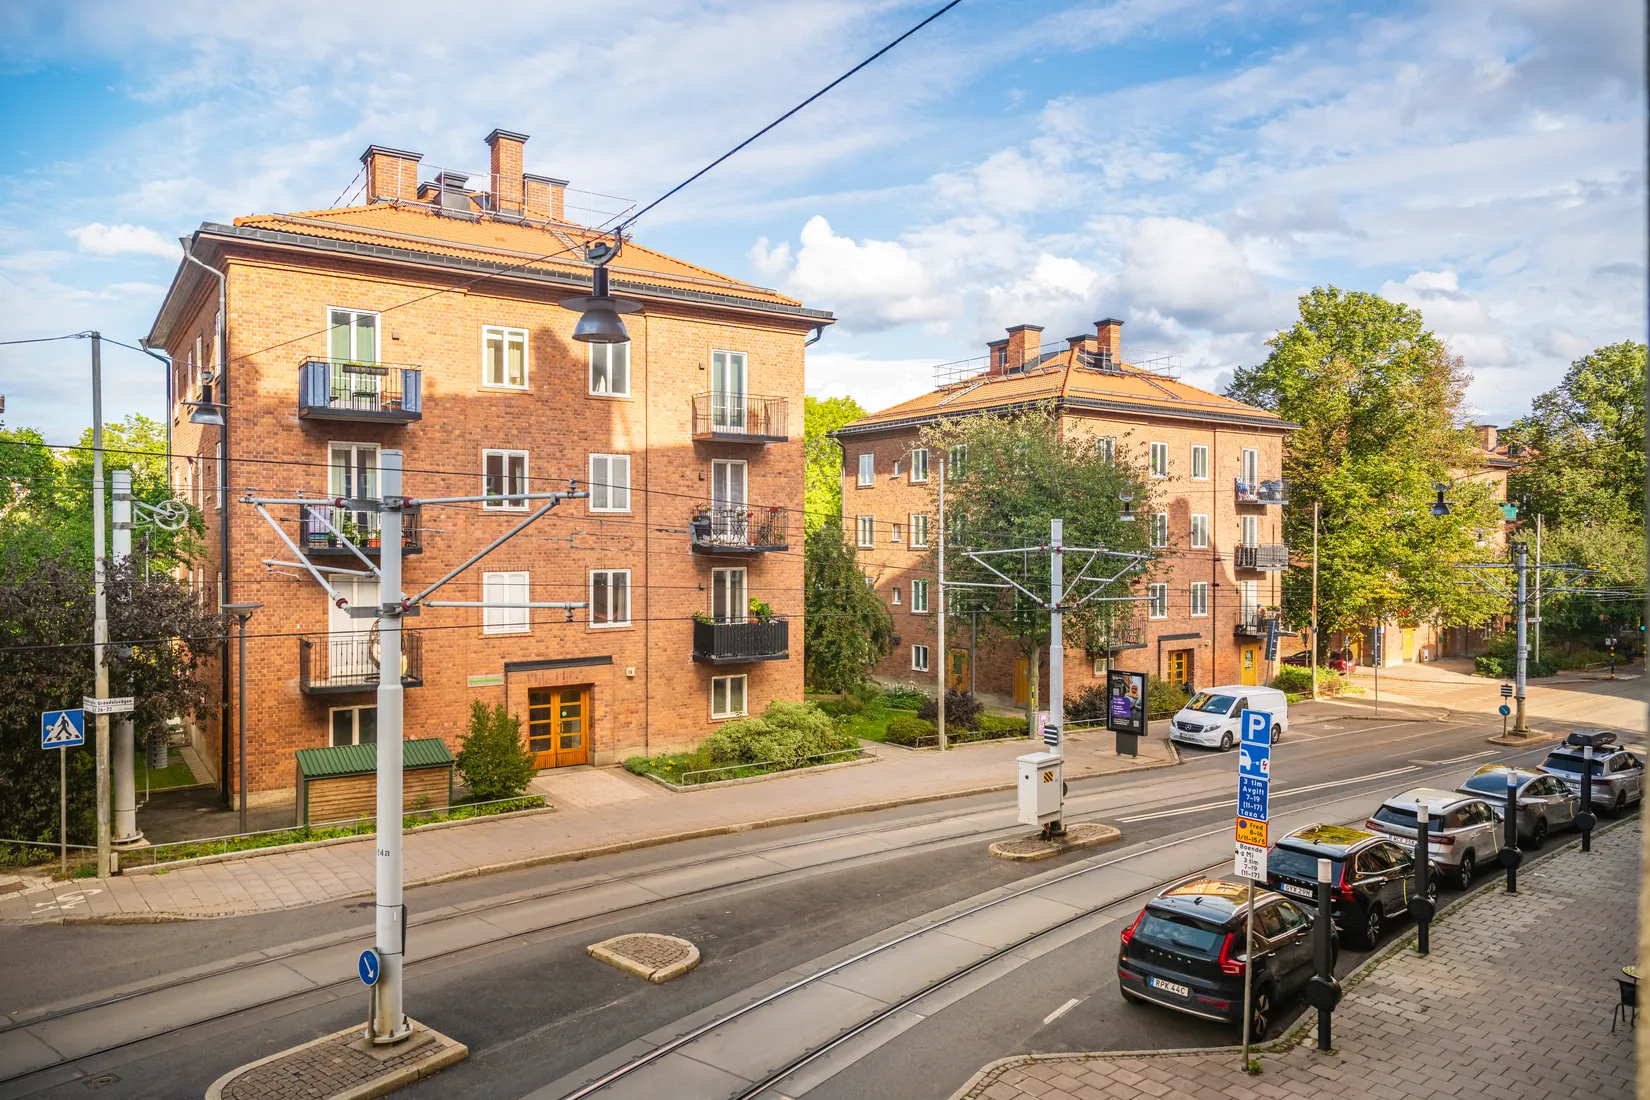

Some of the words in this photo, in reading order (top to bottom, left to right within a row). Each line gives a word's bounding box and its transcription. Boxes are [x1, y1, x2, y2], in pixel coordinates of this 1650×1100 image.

[1248, 714, 1266, 740] P
[1242, 786, 1264, 796] Avgift
[1246, 794, 1260, 802] 7-19
[1243, 801, 1262, 812] (11-17)
[1240, 808, 1258, 818] Taxa
[1250, 822, 1264, 830] Fred
[1250, 830, 1264, 838] 8-16
[1240, 844, 1262, 854] Boende
[1244, 864, 1258, 872] 7-19
[1241, 870, 1260, 880] (11-17)
[1155, 979, 1170, 990] RPK
